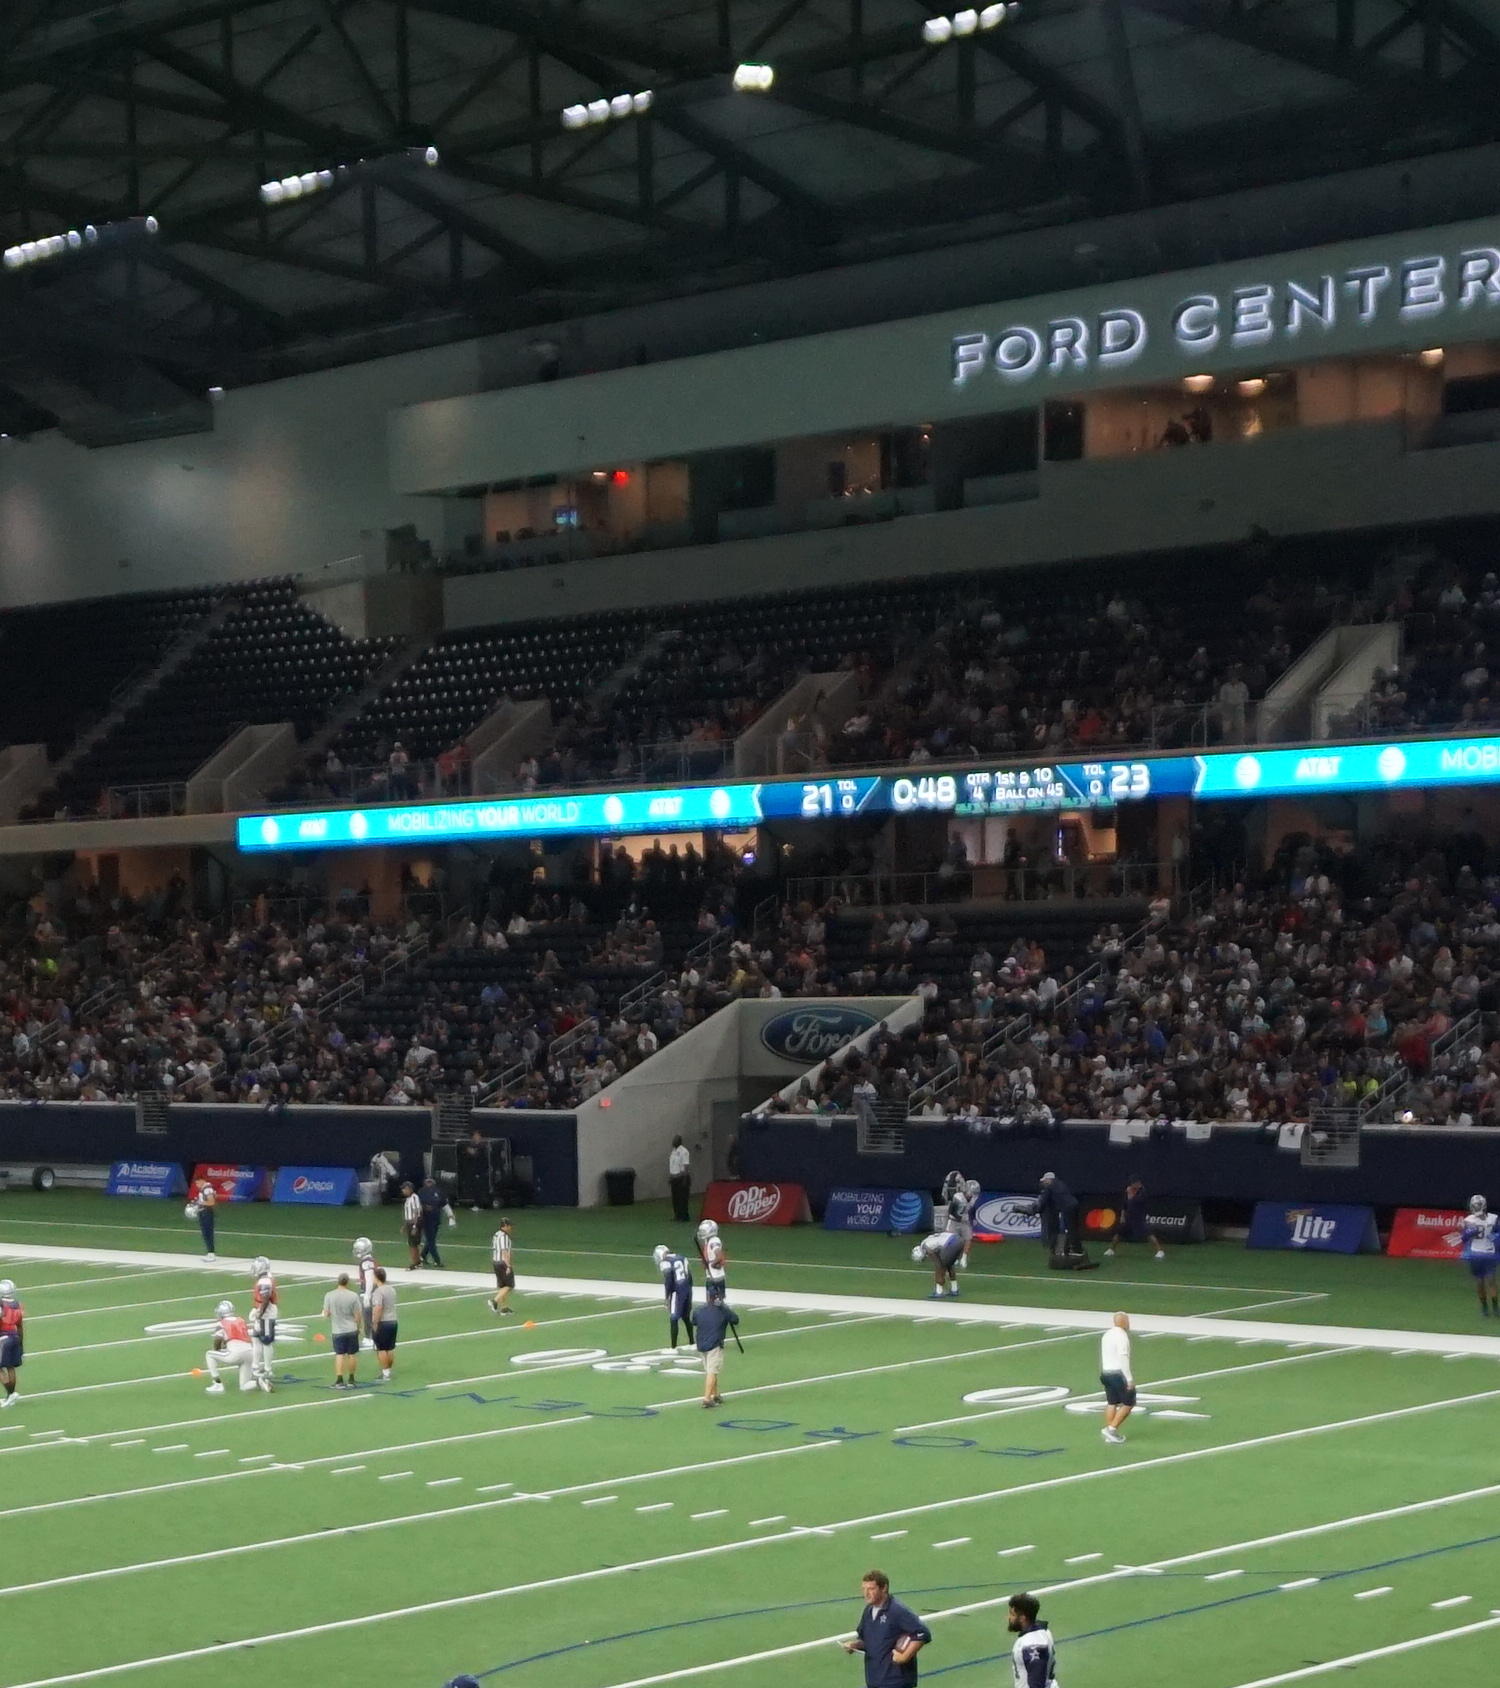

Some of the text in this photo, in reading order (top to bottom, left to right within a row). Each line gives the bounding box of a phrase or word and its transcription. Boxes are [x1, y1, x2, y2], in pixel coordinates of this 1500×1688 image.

[950, 308, 1146, 383] FORD
[1296, 756, 1341, 777] AT&T
[967, 773, 990, 785] QTR
[995, 772, 1015, 785] 1st
[1034, 767, 1052, 782] 10
[1111, 764, 1149, 792] 23
[893, 776, 956, 805] 0:48
[973, 787, 984, 800] 4
[1047, 783, 1063, 796] 45
[802, 784, 833, 811] 21
[388, 802, 579, 831] MOBILIZING YOUR WORLD
[131, 1164, 171, 1178] Academy
[306, 1181, 334, 1191] pepsi
[748, 1185, 766, 1200] Dr
[733, 1190, 777, 1218] Pepper
[832, 1192, 884, 1203] MOBILIZING
[857, 1204, 882, 1214] YOUR
[847, 1215, 878, 1225] WORLD
[1417, 1214, 1444, 1227] Bank
[1291, 1214, 1336, 1244] Lite
